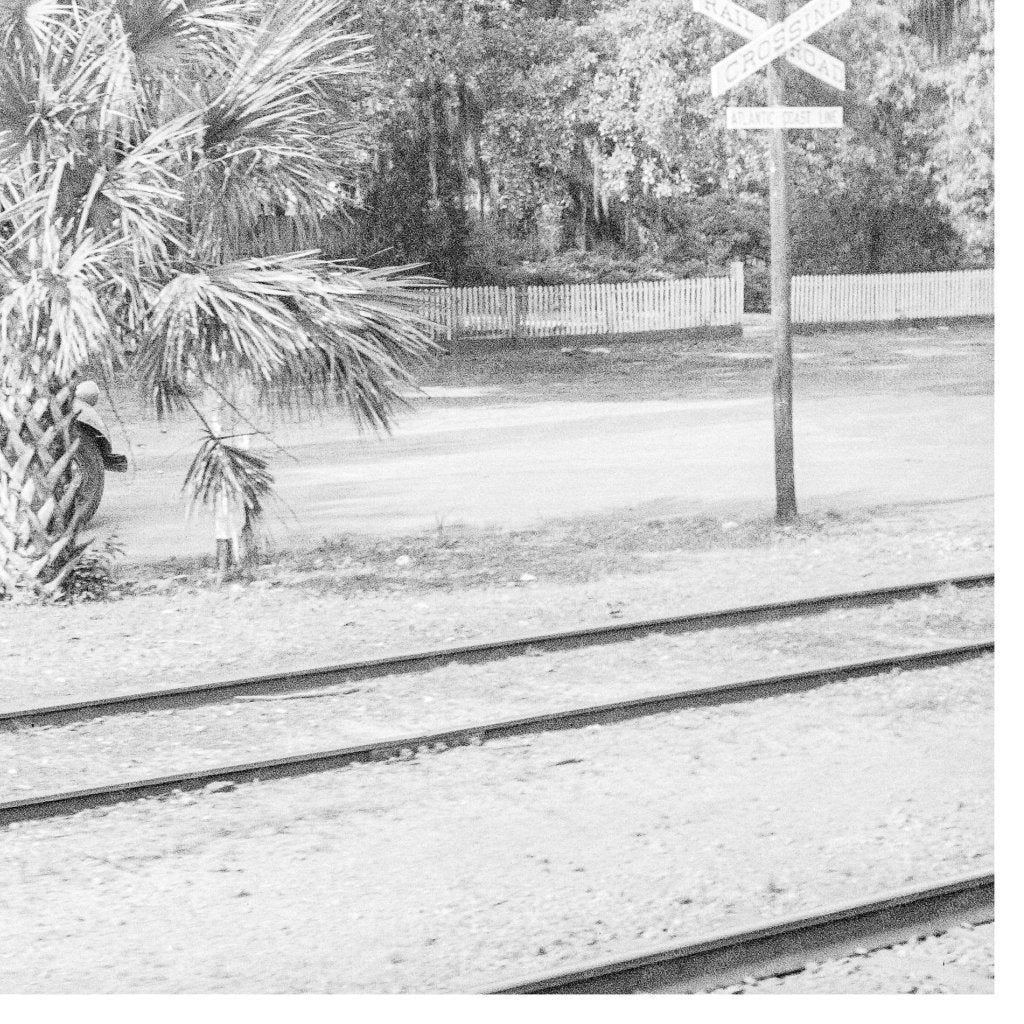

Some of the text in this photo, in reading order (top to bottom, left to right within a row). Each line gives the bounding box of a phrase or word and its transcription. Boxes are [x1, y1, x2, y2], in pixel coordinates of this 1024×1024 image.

[787, 43, 845, 84] ROAD
[731, 109, 838, 126] ATLANTIC COAST LINE
